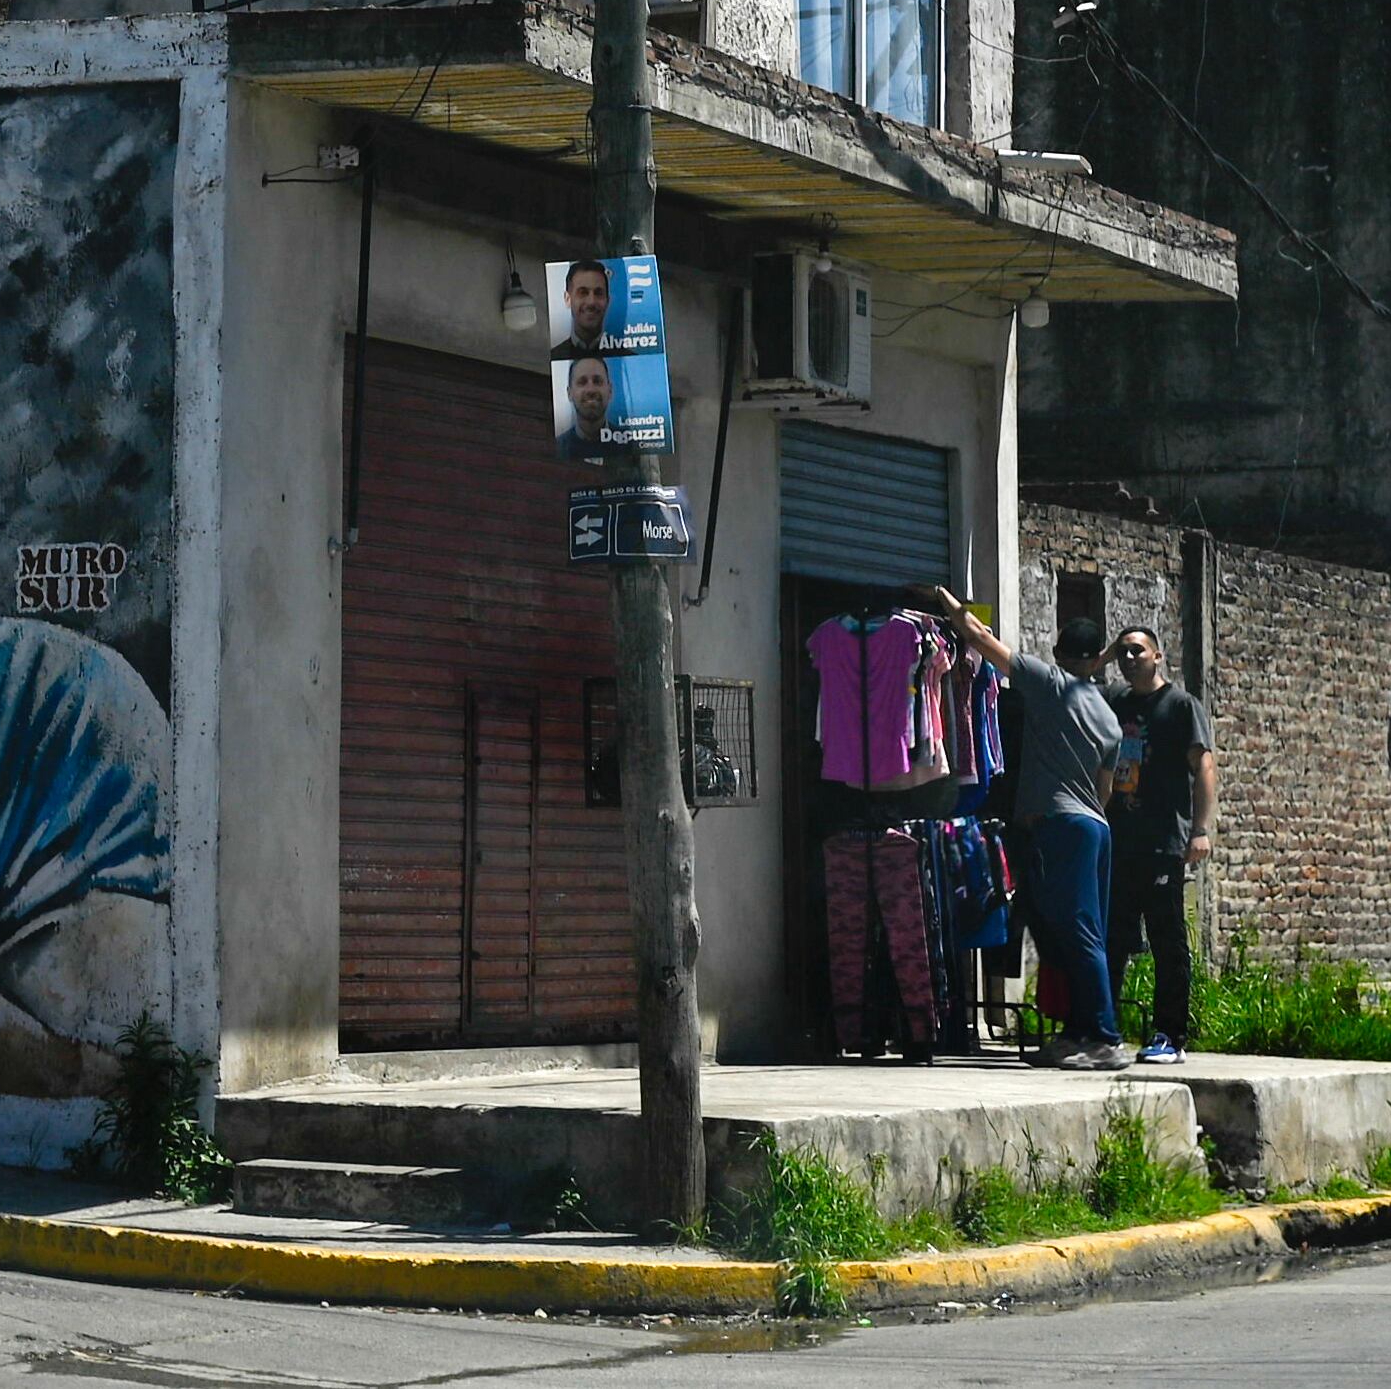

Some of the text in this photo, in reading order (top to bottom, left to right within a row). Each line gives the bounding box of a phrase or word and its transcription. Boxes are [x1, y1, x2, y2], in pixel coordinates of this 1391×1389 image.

[623, 322, 657, 335] Julián
[599, 331, 658, 350] Álvarez
[618, 414, 665, 427] Leandro
[600, 425, 665, 444] Decuzzi
[642, 519, 673, 540] Morse
[19, 545, 126, 576] MURO
[18, 576, 109, 610] SUR
